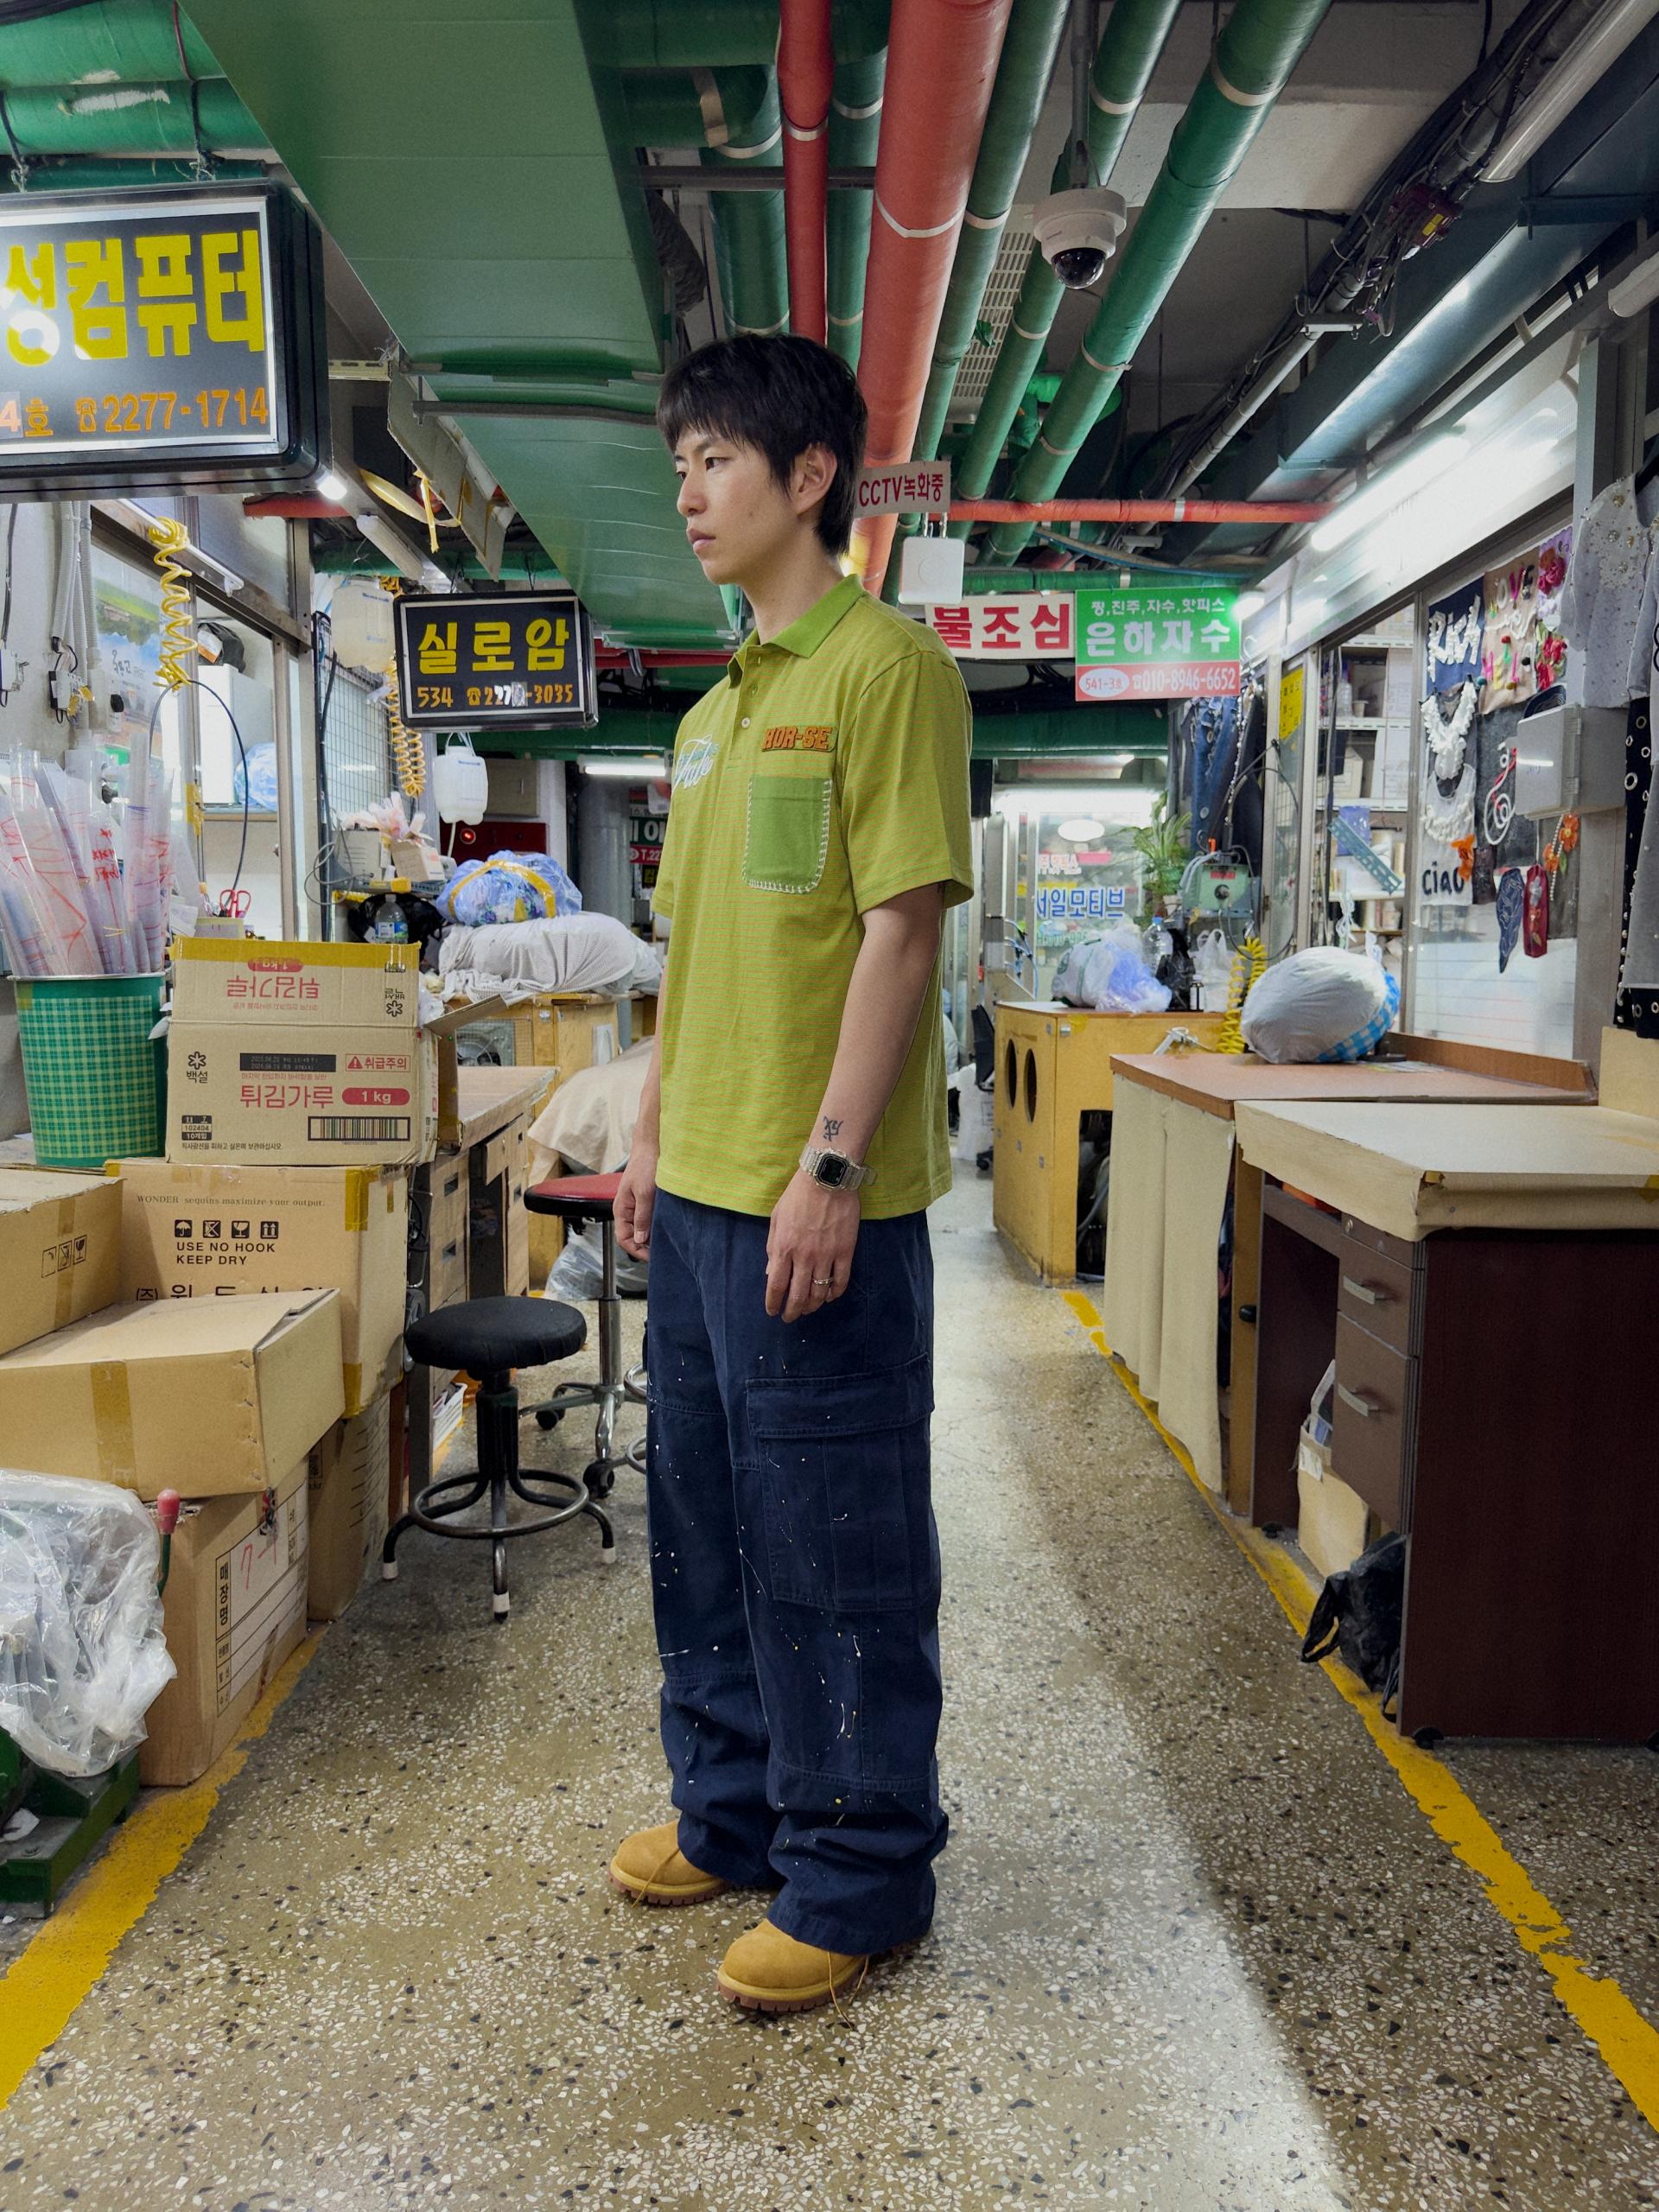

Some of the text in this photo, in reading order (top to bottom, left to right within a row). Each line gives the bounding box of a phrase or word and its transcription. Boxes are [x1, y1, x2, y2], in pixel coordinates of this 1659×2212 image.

[3, 230, 265, 367] 성컴퓨터
[103, 387, 269, 433] 2277-1714
[859, 473, 944, 507] CCTV녹화중
[418, 619, 570, 675] 실로암
[1086, 620, 1230, 658] 은하자수
[417, 686, 454, 709] 534
[761, 726, 833, 751] HOR-SE
[364, 1057, 408, 1071] 취급주의
[186, 1071, 208, 1084] 백설
[240, 1085, 334, 1109] 튀김가루
[373, 1090, 392, 1103] kg
[137, 1195, 180, 1204] WONDER
[176, 1242, 276, 1253] USE NO HOOK
[176, 1255, 248, 1266] KEEP DRY
